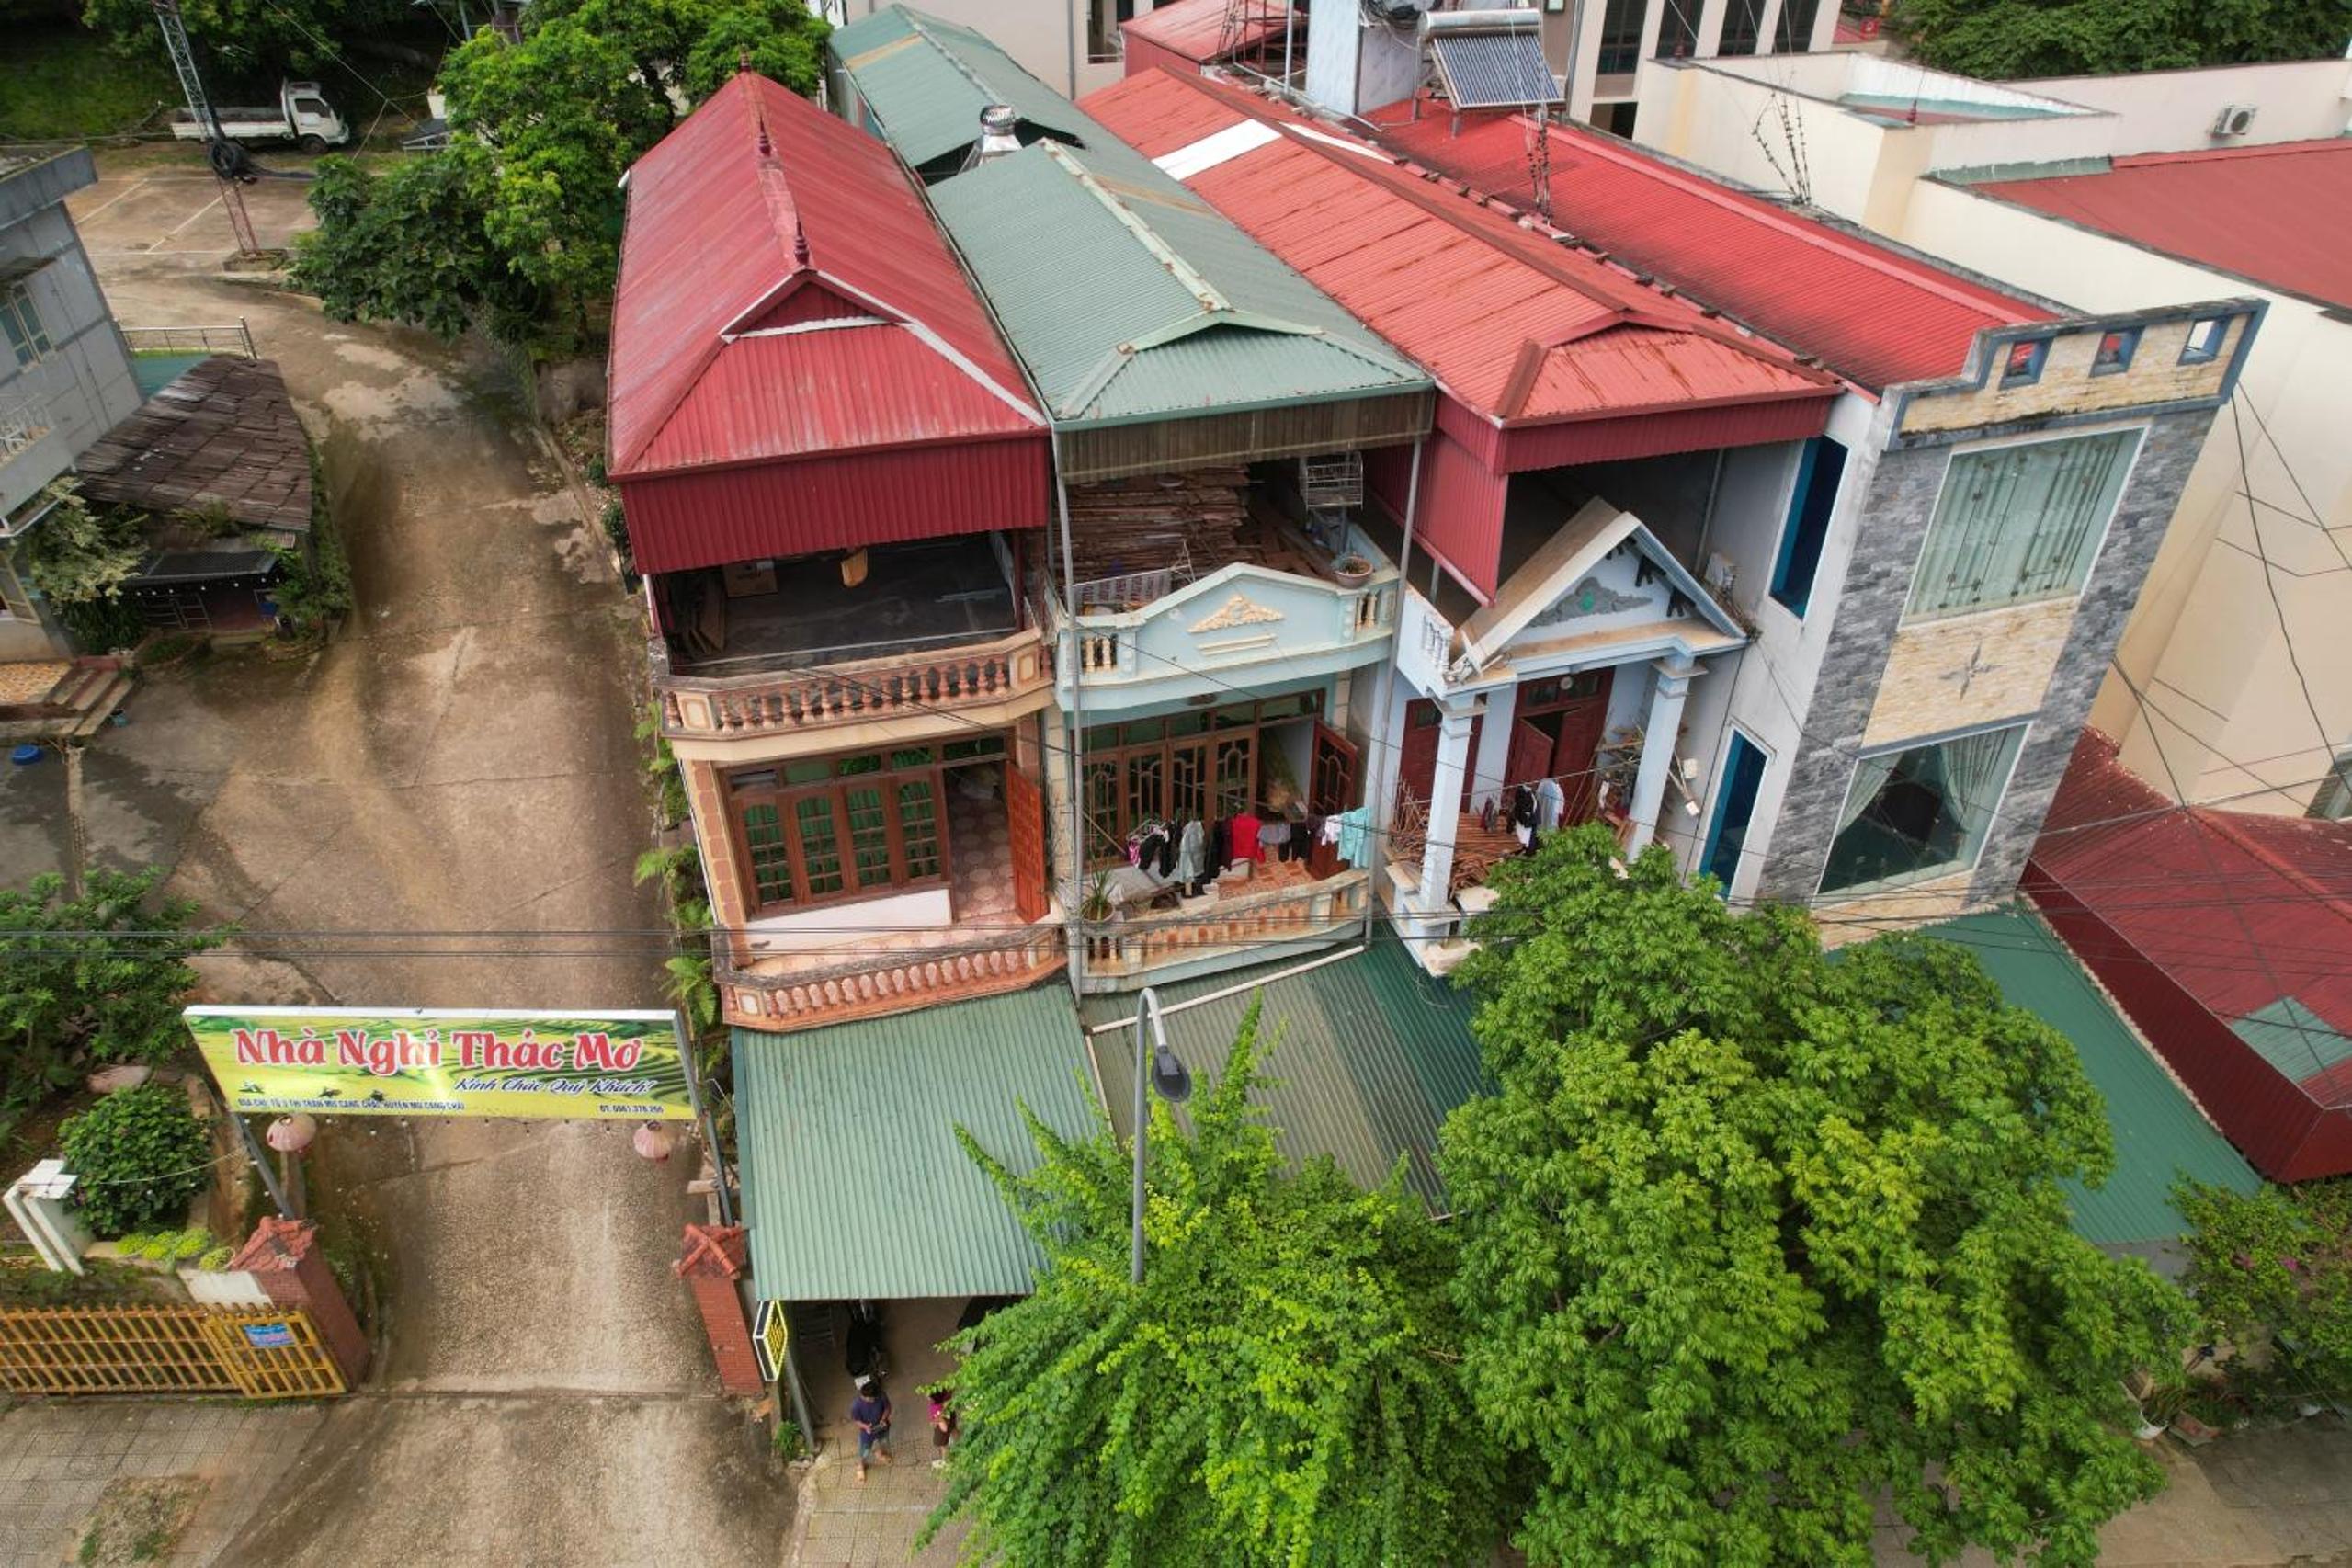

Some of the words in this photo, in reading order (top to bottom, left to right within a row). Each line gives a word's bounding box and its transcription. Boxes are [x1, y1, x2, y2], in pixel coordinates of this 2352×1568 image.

[233, 1028, 326, 1065] Nhà
[335, 1029, 440, 1076] Nghỉ
[451, 1030, 566, 1069] Thác
[575, 1033, 642, 1070] Mơ
[454, 1078, 499, 1092] Kính
[549, 1079, 588, 1095] Quý
